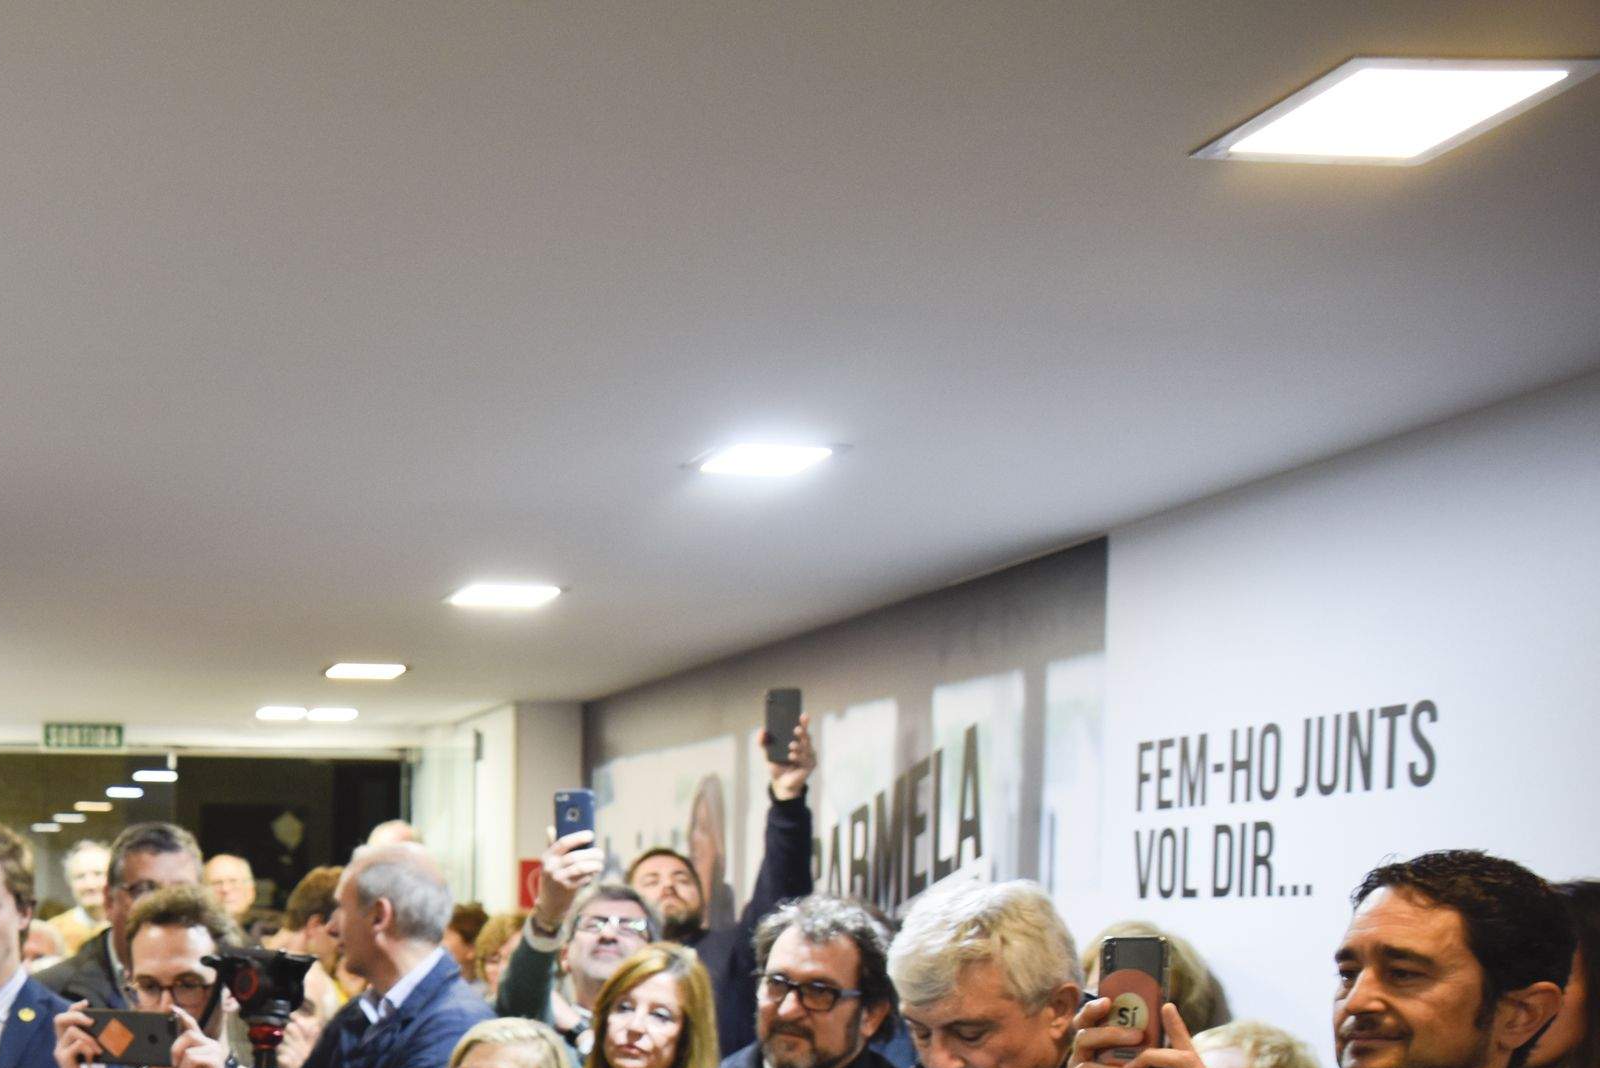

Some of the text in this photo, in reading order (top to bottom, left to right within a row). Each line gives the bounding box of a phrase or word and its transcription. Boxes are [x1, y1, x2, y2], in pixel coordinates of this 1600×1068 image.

[1135, 698, 1438, 812] FEM-HO JUNTS
[1134, 820, 1313, 899] VOL DIR...
[1117, 1006, 1138, 1027] Sí
